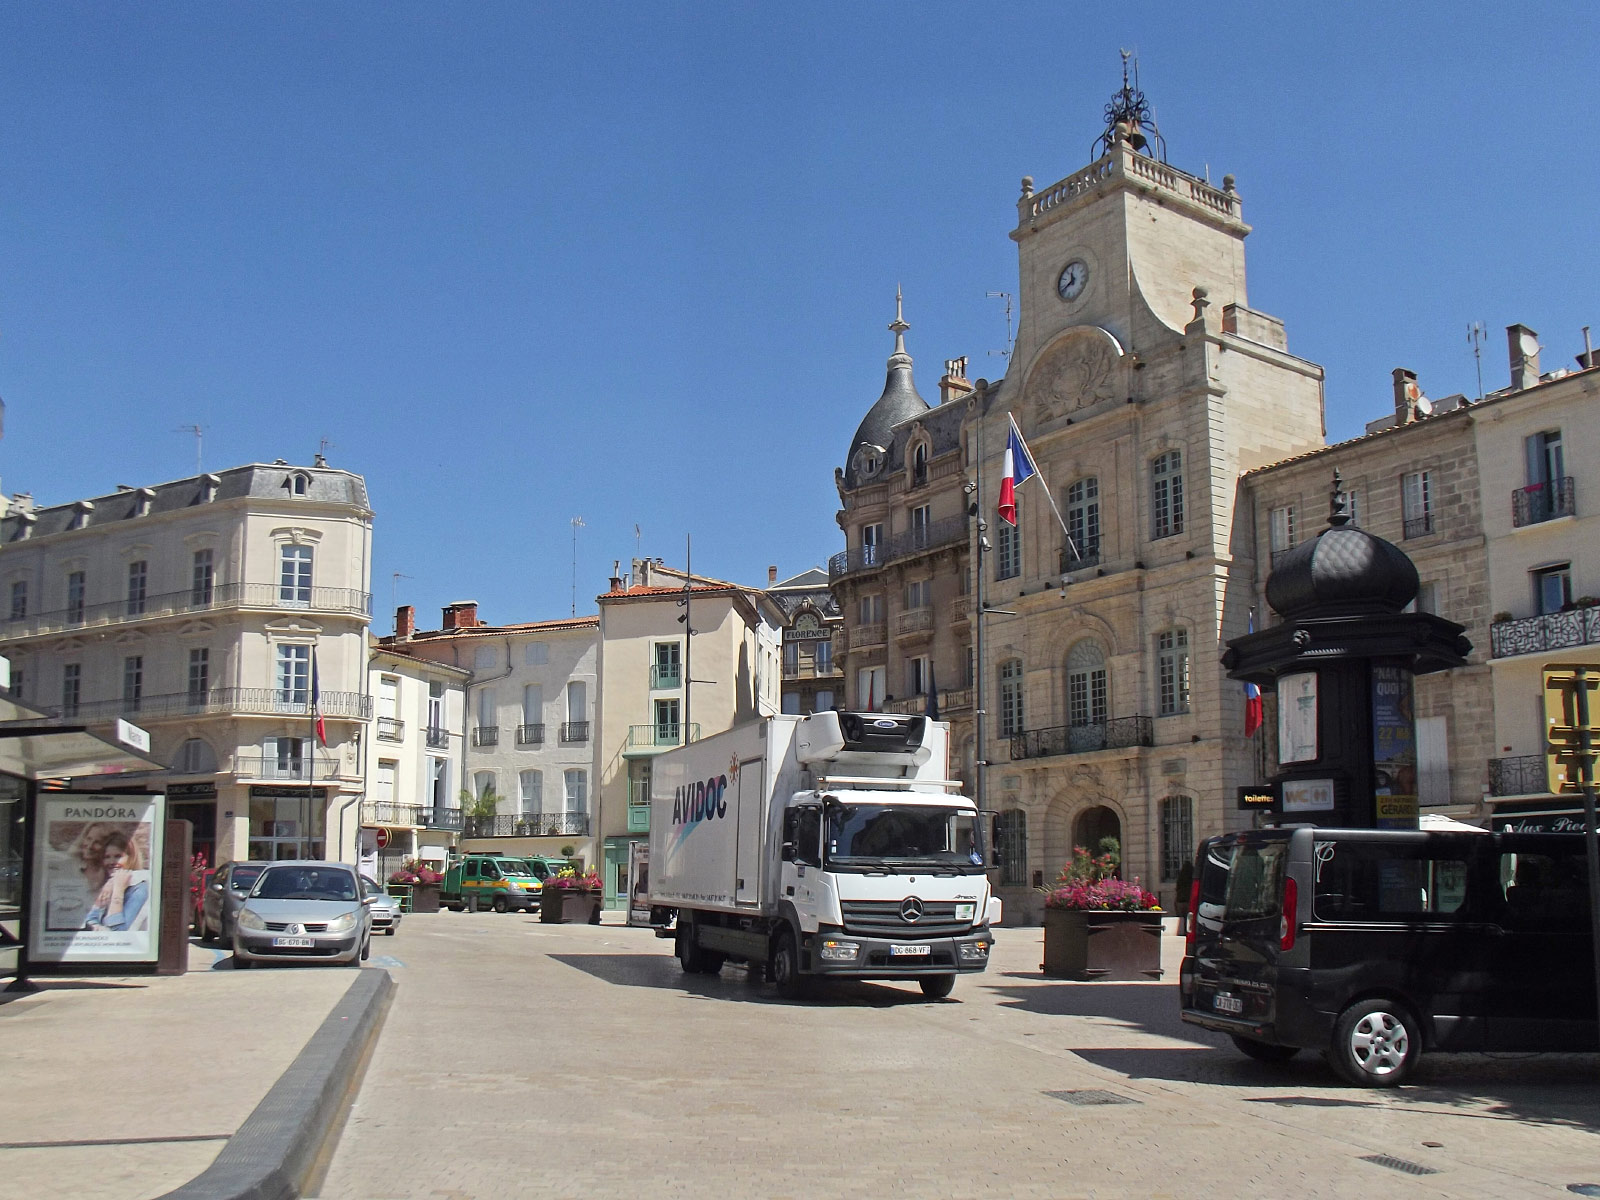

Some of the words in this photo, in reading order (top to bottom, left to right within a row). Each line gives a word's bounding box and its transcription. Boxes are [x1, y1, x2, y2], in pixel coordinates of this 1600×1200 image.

[786, 629, 828, 639] FLORENCE
[672, 774, 728, 825] AVIDOC
[1244, 794, 1274, 803] toilettes
[1285, 789, 1309, 804] WC
[65, 807, 137, 818] PANDORA
[1503, 819, 1544, 833] Aux
